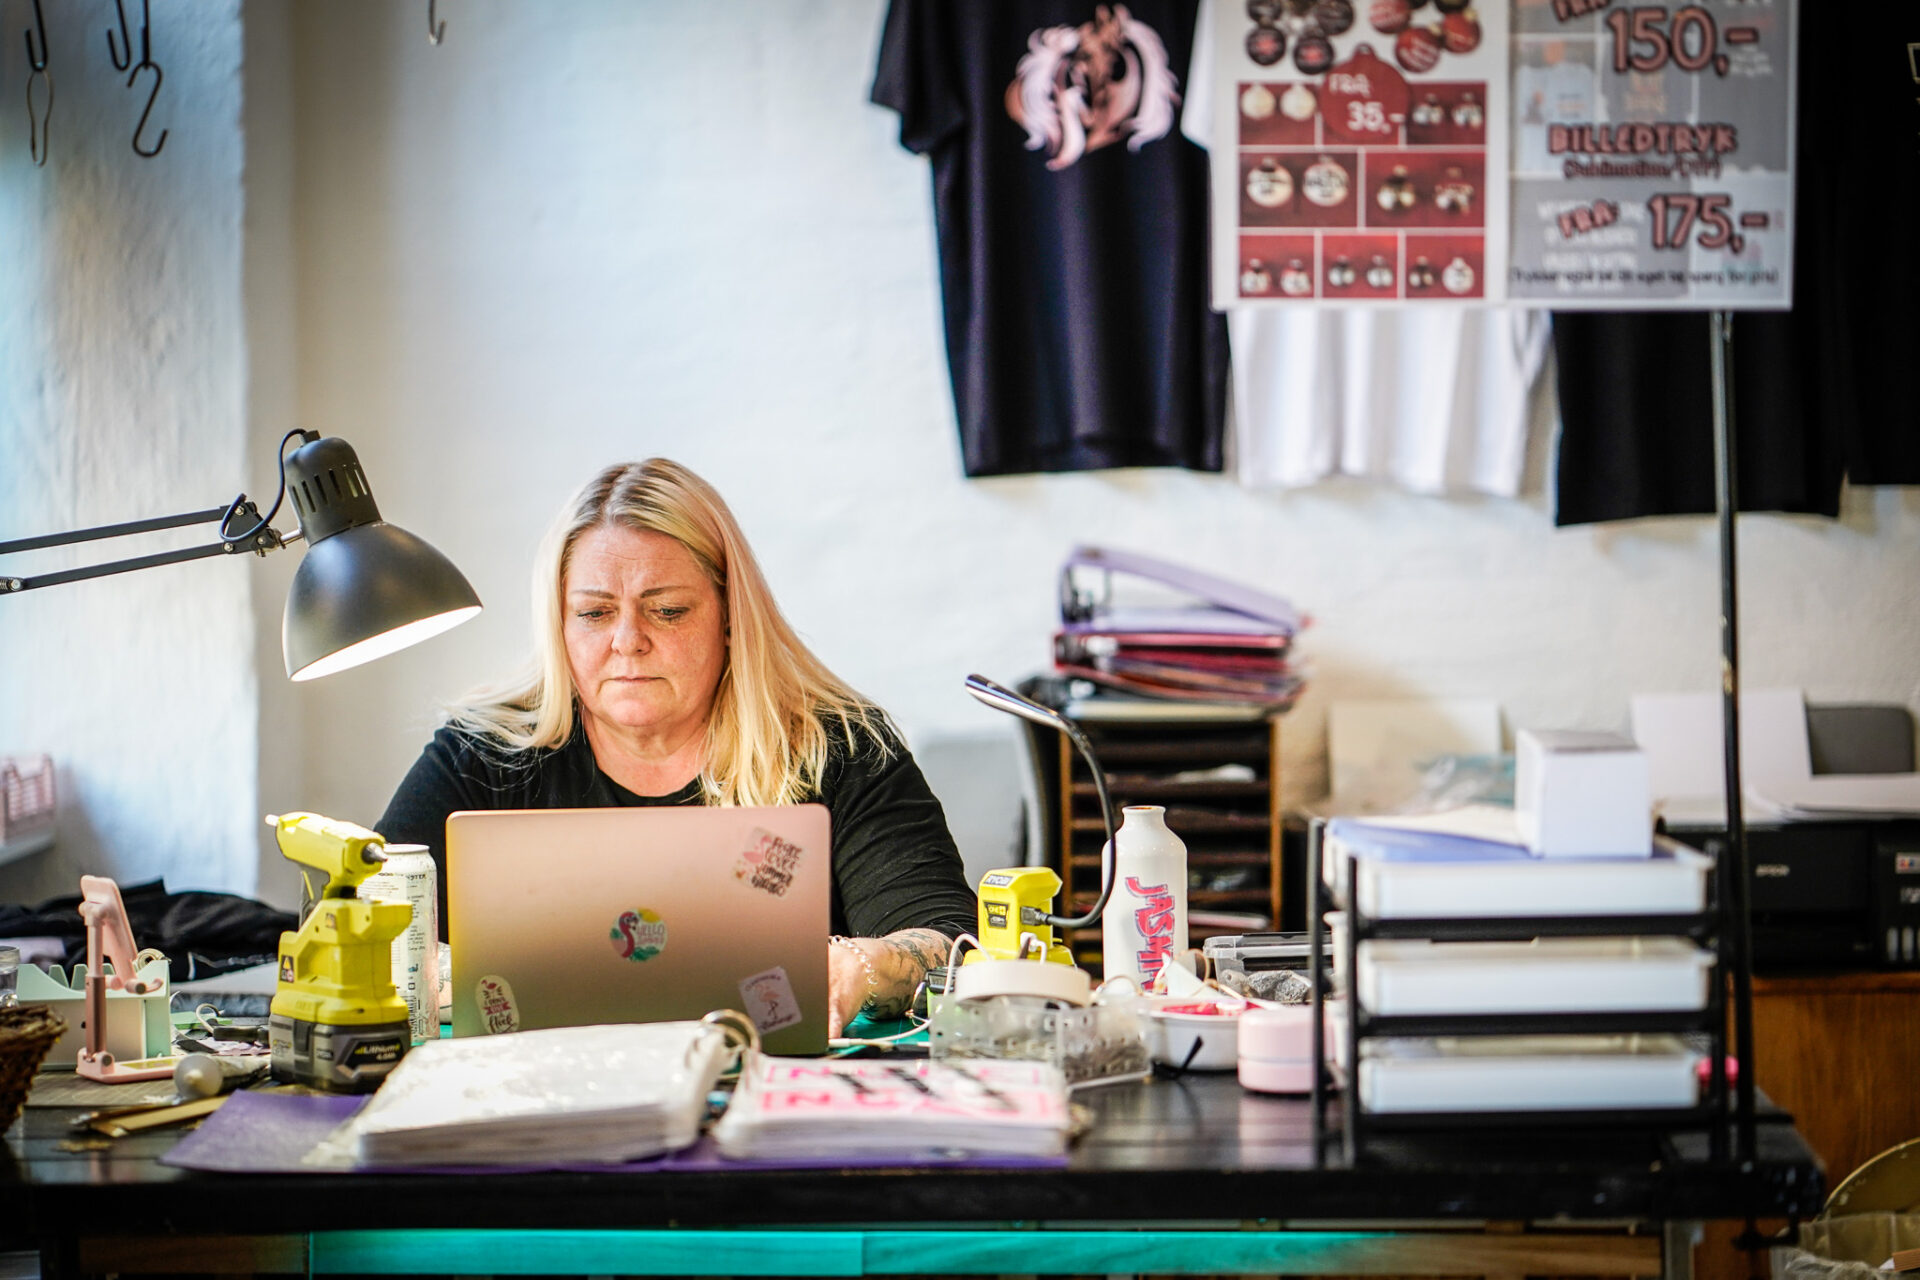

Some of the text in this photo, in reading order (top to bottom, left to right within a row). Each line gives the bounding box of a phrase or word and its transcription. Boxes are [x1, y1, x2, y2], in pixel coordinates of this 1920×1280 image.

[1607, 6, 1759, 76] 150,-
[1549, 123, 1737, 153] BILLEDTRYK
[1648, 193, 1769, 253] 175,-
